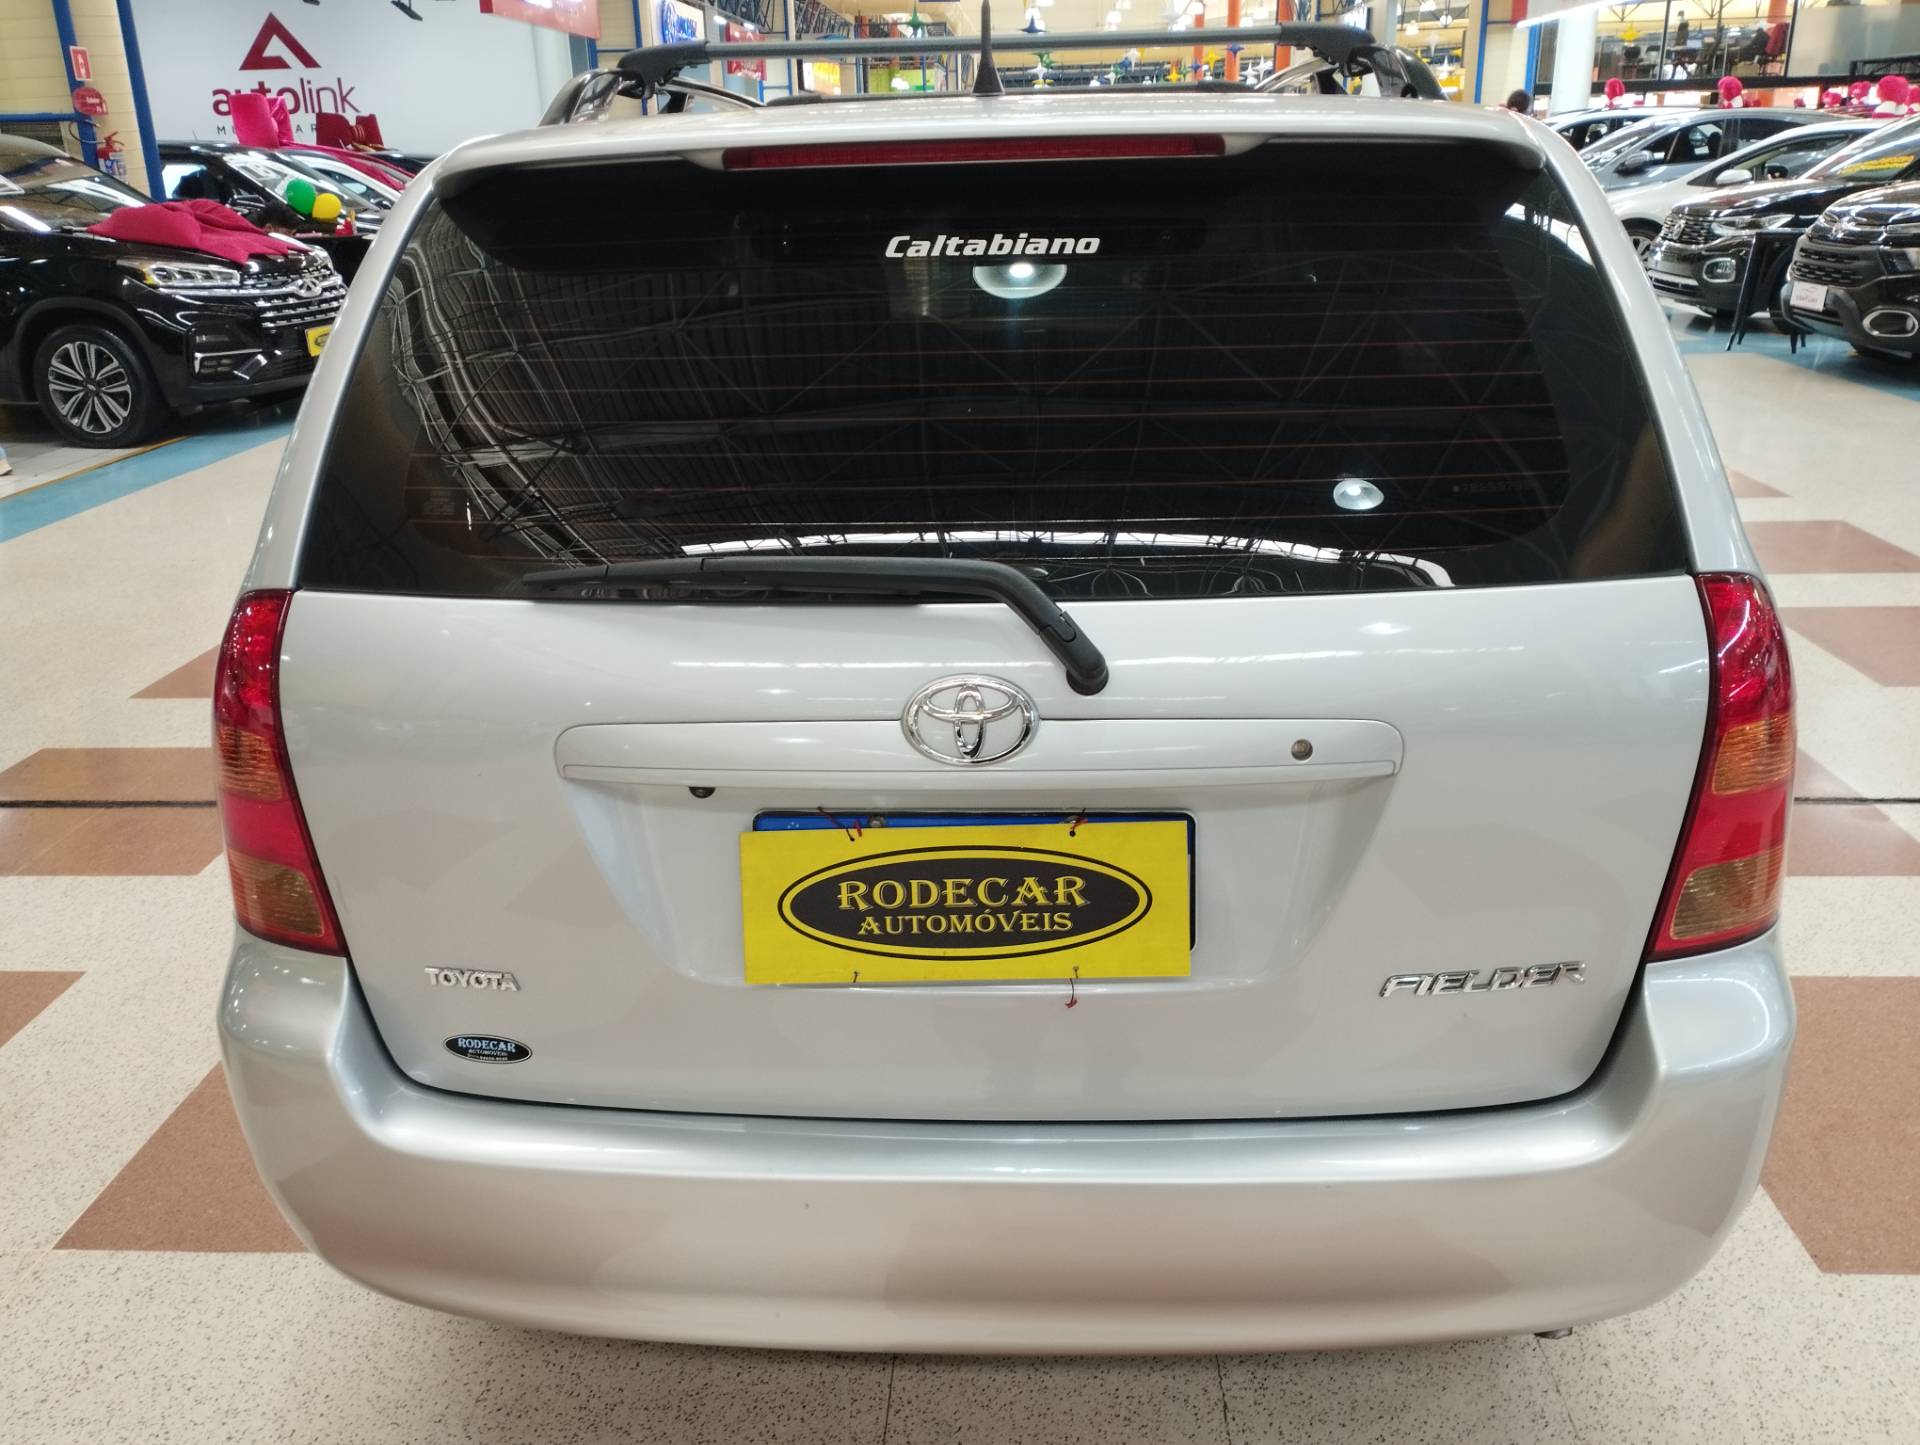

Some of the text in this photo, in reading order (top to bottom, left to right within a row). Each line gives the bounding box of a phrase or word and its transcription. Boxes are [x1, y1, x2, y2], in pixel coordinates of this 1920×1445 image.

[885, 232, 1101, 259] Caltabiano
[837, 875, 1090, 911] RODECAR
[857, 909, 1073, 936] AUTOMÓVEIS
[424, 966, 521, 992] TOYOTA
[1378, 960, 1586, 998] FIELDER
[457, 1037, 516, 1053] RODECAR
